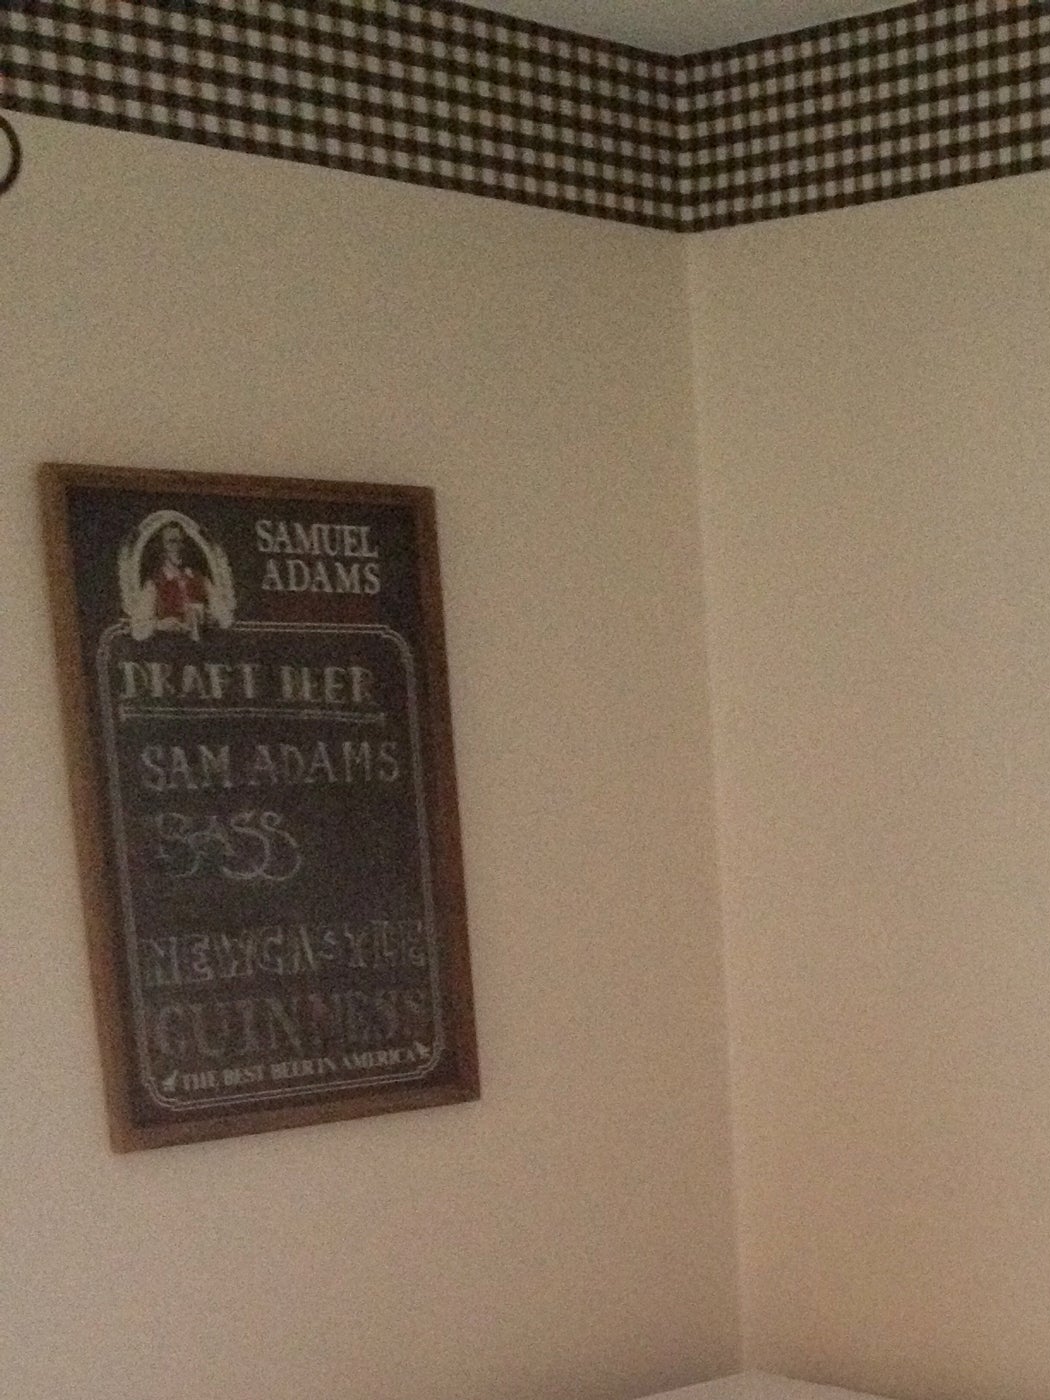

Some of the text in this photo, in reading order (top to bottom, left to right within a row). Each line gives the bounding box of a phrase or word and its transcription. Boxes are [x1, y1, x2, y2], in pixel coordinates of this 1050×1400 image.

[255, 520, 378, 558] SAMUEL
[261, 559, 381, 595] ADAMS
[119, 662, 377, 704] DRAFT BEER
[140, 741, 401, 791] SAM ADAMS
[182, 1048, 416, 1091] THE BEST BEER IN AMERICA
